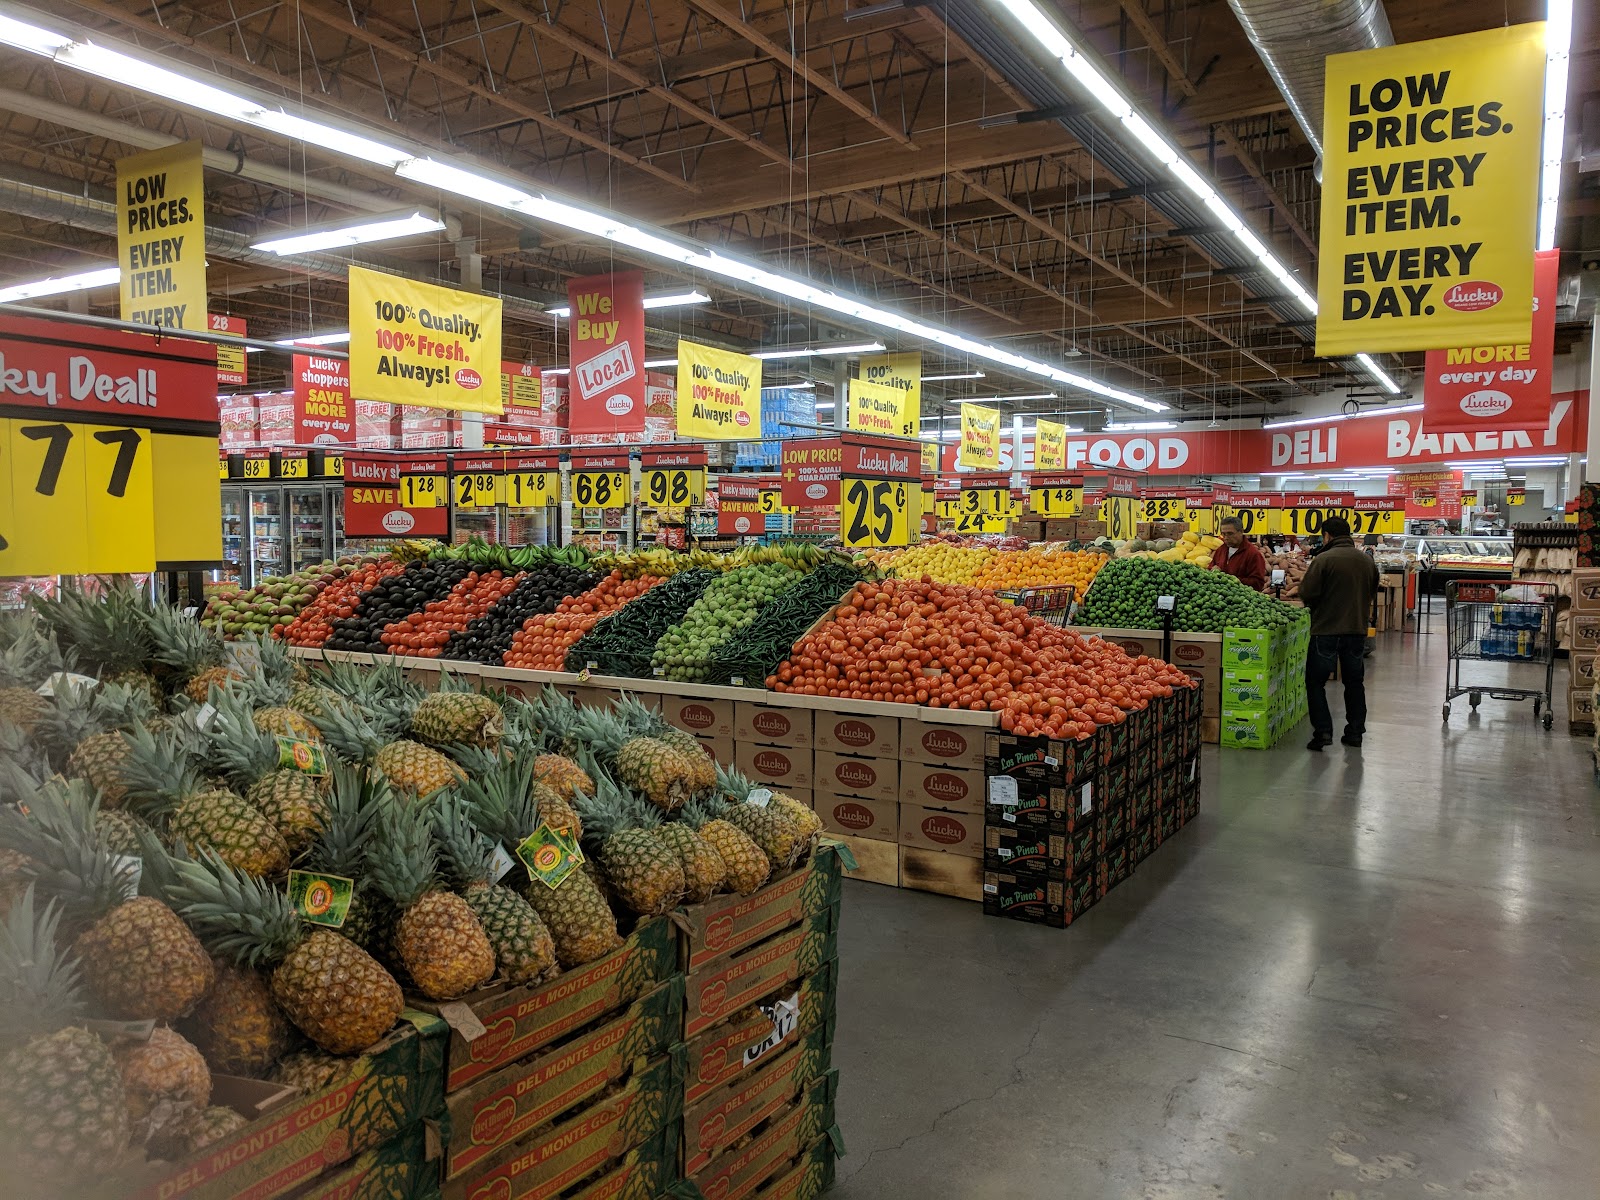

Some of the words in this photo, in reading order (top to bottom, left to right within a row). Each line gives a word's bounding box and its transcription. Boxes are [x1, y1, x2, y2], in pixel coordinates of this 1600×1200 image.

[1350, 70, 1451, 116] LOW
[1348, 102, 1514, 153] PRICES.
[1347, 152, 1487, 200] EVERY
[127, 173, 167, 205] LOW
[128, 197, 193, 234] PRICES.
[1345, 194, 1461, 236] ITEM.
[130, 236, 184, 270] EVERY
[1344, 242, 1483, 284] EVERY
[131, 269, 177, 298] ITEM.
[577, 293, 612, 315] We
[1342, 284, 1436, 321] DAY.
[1448, 285, 1498, 303] Lucky
[132, 304, 187, 328] EVERY
[375, 300, 416, 323] 100%
[419, 309, 481, 342] Quality.
[578, 319, 619, 344] Buy
[376, 329, 415, 352] 100%
[418, 335, 469, 363] Fresh.
[1446, 344, 1531, 366] MORE
[309, 357, 341, 374] Lucky
[377, 356, 450, 387] Always!
[457, 371, 481, 385] Lucky
[581, 350, 631, 390] Local
[867, 365, 892, 379] 100%
[70, 356, 157, 408] Deal!
[217, 373, 243, 383] PRICES
[302, 370, 349, 388] shoppers
[692, 364, 713, 380] 100%
[714, 368, 750, 391] Quality.
[1439, 369, 1496, 386] every
[1499, 366, 1537, 384] day
[308, 389, 343, 404] SAVE
[608, 399, 631, 410] Lucky
[692, 385, 713, 401] 100%
[715, 388, 743, 406] Fresh.
[1465, 394, 1507, 409] Lucky
[305, 402, 347, 418] MORE
[692, 404, 732, 426] Always!
[873, 399, 898, 417] Quality.
[302, 419, 330, 431] every
[332, 420, 350, 432] day
[873, 417, 893, 430] Fresh.
[495, 430, 517, 443] Lucky
[518, 433, 532, 443] Deal!
[1271, 426, 1337, 467] DELI
[518, 459, 534, 469] Lucky
[584, 458, 602, 467] Lucky
[656, 455, 675, 465] Lucky
[783, 450, 808, 465] LOW
[857, 447, 888, 474] Lucky
[889, 453, 909, 473] Deal!
[998, 438, 1189, 471] SEFOOD
[352, 462, 388, 481] Lucky
[411, 463, 426, 472] Lucky
[466, 461, 482, 470] Lucky
[577, 473, 622, 505] 68¢
[650, 471, 689, 504] 98
[722, 482, 738, 498] Lucky
[972, 480, 988, 488] Lucky
[1042, 479, 1060, 487] Lucky
[352, 488, 393, 504] SAVE
[966, 490, 980, 513] 3
[992, 490, 1001, 513] 1
[1253, 497, 1270, 506] Deal!
[1297, 496, 1325, 507] Lucky
[1325, 497, 1342, 506] Deal!
[1354, 500, 1377, 509] Lucky
[722, 502, 741, 514] SAVE
[847, 480, 906, 544] 25¢
[1146, 499, 1177, 517] 88¢
[385, 513, 412, 528] Lucky
[1178, 646, 1202, 658] Lucky
[683, 708, 712, 724] Lucky
[757, 714, 787, 732] Lucky
[838, 723, 871, 742] Lucky
[926, 732, 963, 753] Lucky
[757, 754, 787, 772] Lucky
[1001, 757, 1015, 770] Los
[1015, 752, 1038, 763] Pinos
[839, 764, 872, 783] Lucky
[927, 776, 964, 797] Lucky
[1018, 799, 1039, 810] Pinos
[837, 807, 870, 826] Lucky
[926, 819, 962, 840] Lucky
[1015, 845, 1038, 857] Pinos
[735, 903, 752, 917] DEL
[753, 886, 782, 907] MONTE
[784, 875, 804, 892] GOLD
[1001, 896, 1013, 909] Los
[1014, 891, 1037, 902] Pinos
[727, 966, 744, 981] DEL
[746, 949, 777, 971] MONTE
[778, 937, 801, 954] GOLD
[517, 1001, 543, 1018] DEL
[546, 976, 590, 1003] MONTE
[593, 956, 623, 981] GOLD
[727, 1035, 745, 1048] DEL
[516, 1077, 543, 1096] DEL
[545, 1046, 590, 1080] MONTE
[593, 1026, 625, 1053] GOLD
[725, 1097, 743, 1114] DEL
[744, 1078, 774, 1103] MONTE
[775, 1060, 796, 1081] GOLD
[158, 1167, 206, 1200] DEL
[212, 1121, 290, 1174] MONTE
[296, 1091, 349, 1128] GOLD
[511, 1154, 538, 1176] DEL
[541, 1124, 588, 1161] MONTE
[590, 1103, 625, 1130] GOLD
[729, 1160, 747, 1175] DEL
[748, 1138, 778, 1164] MONTE
[779, 1115, 800, 1136] GOLD
[591, 1176, 624, 1200] GOLD
[779, 1174, 801, 1194] GOLD
